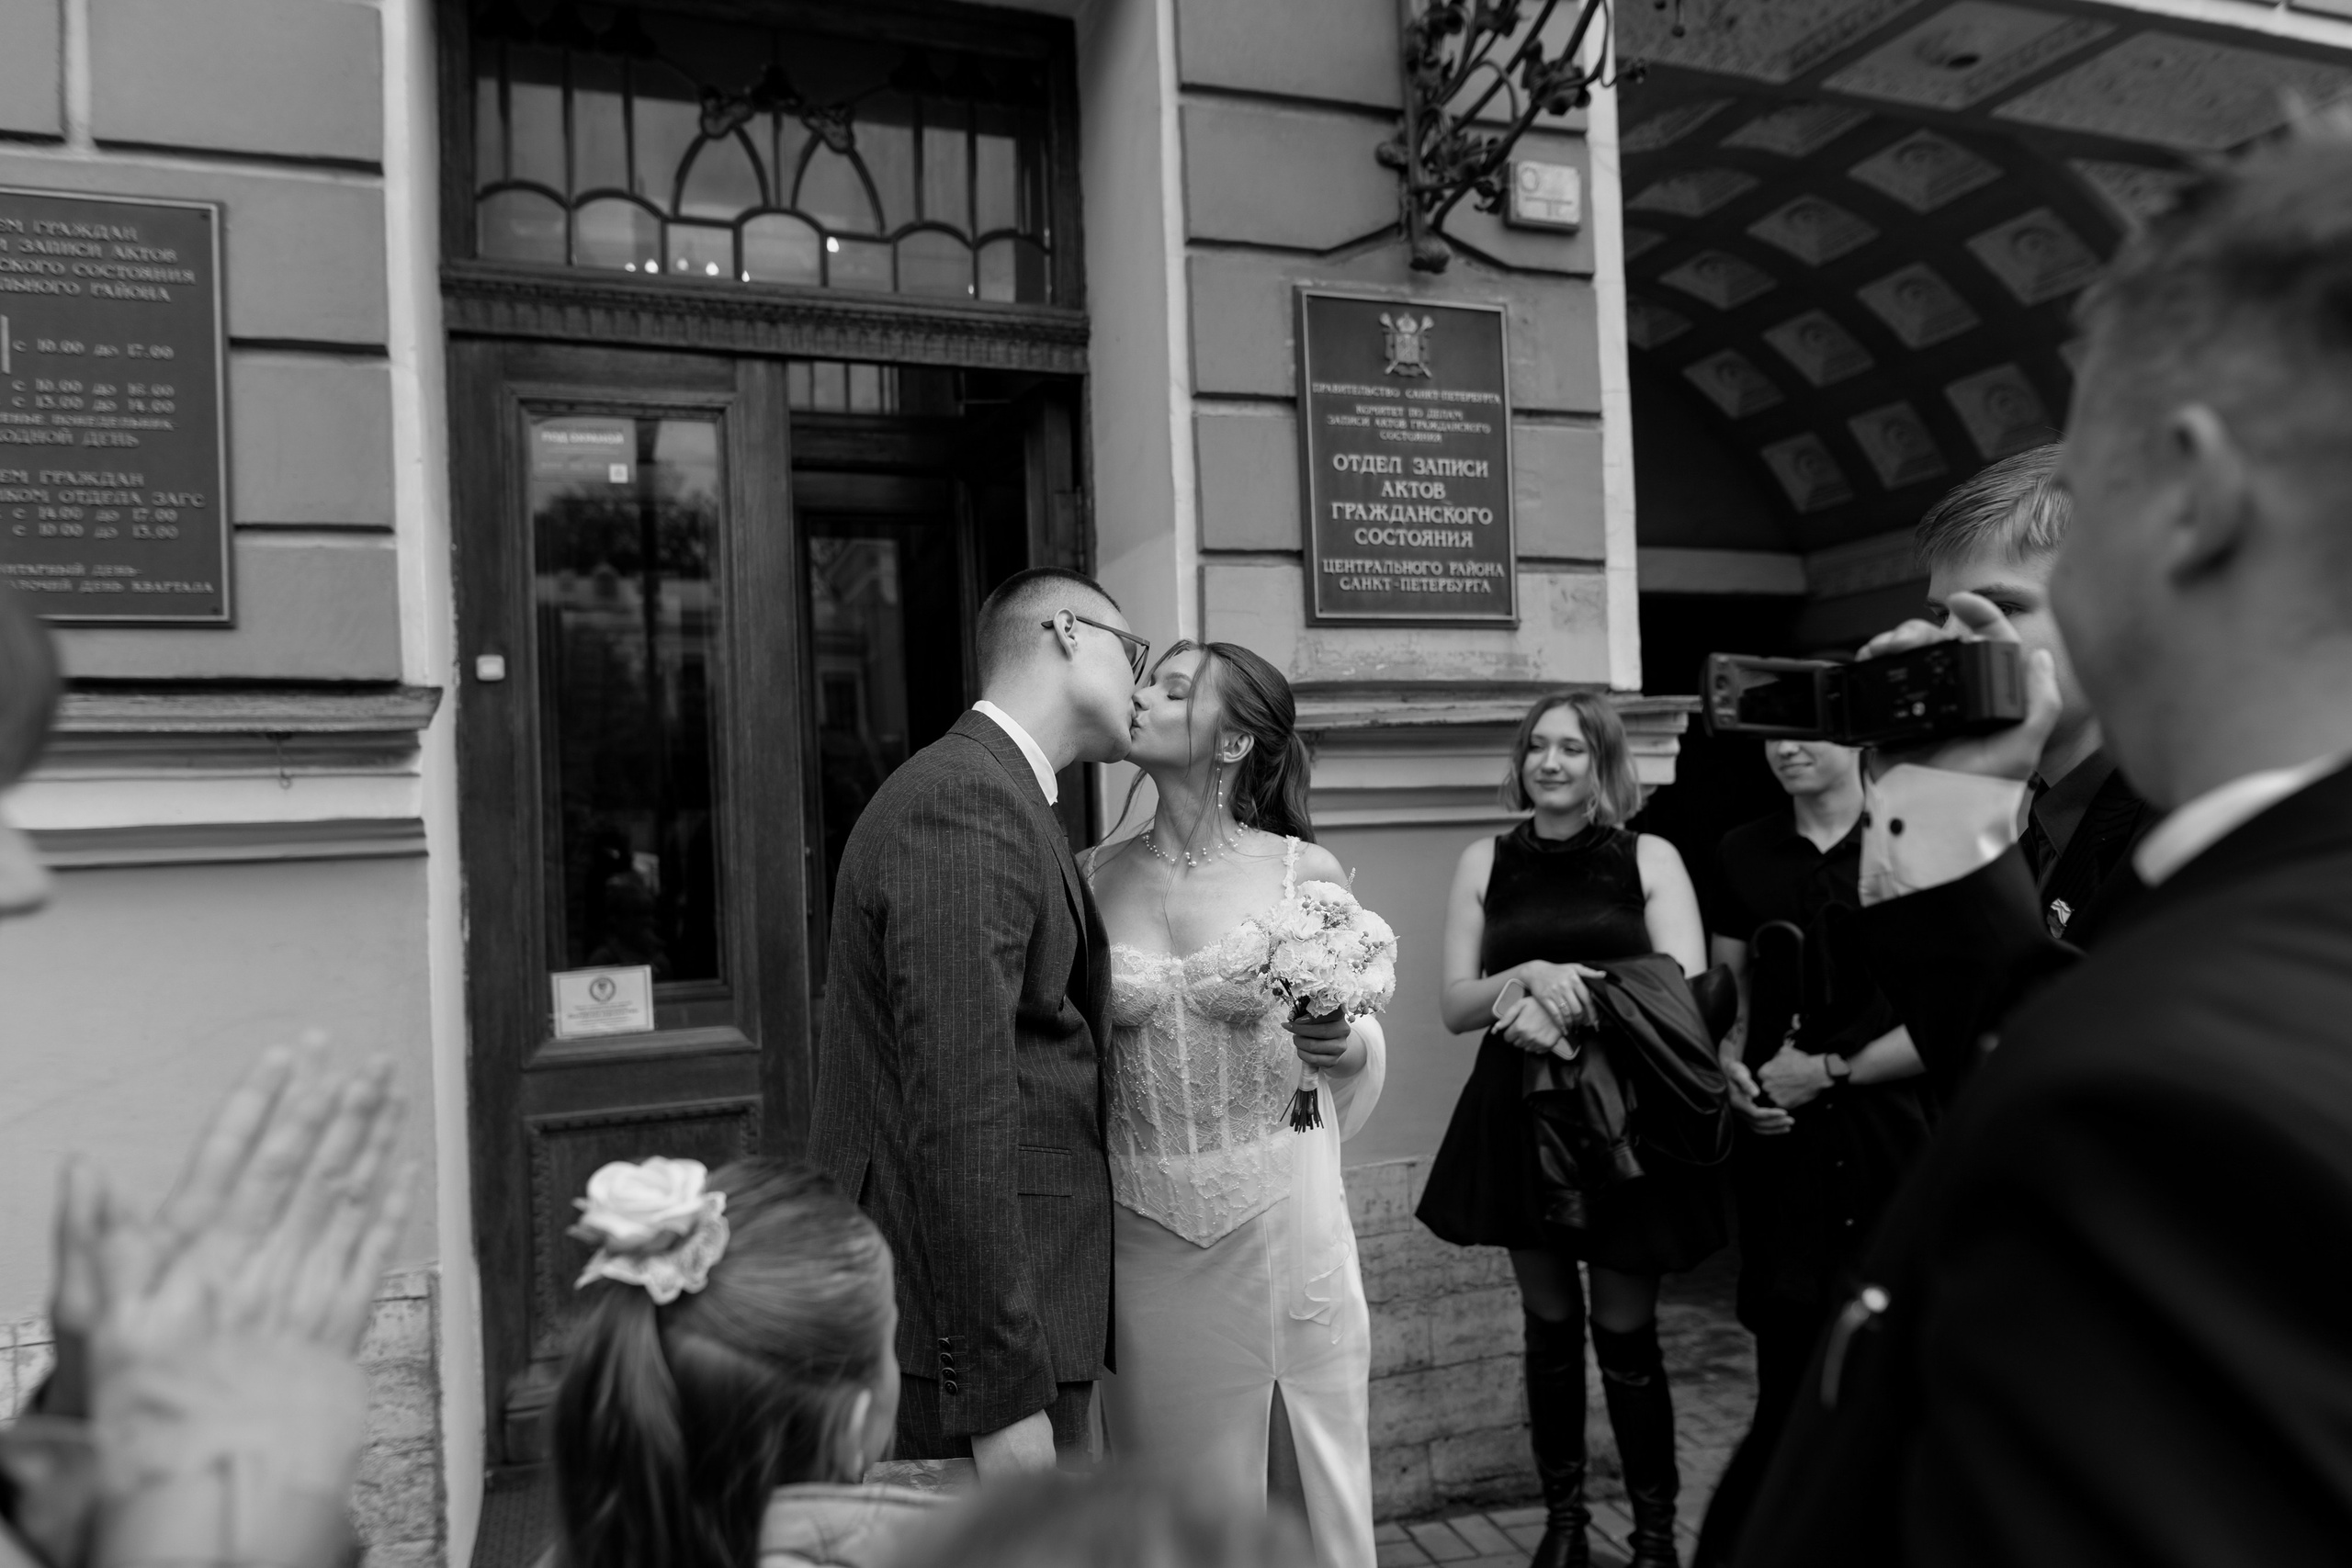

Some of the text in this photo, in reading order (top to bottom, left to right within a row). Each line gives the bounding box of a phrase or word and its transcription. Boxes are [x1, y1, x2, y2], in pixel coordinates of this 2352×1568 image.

[33, 220, 138, 243] ГРАЖДАН
[18, 238, 103, 258] ЗАПИСИ
[111, 244, 178, 265] АКТОВ
[72, 264, 196, 286] СОСТОЯНИЯ
[90, 281, 171, 303] РАЙОНА
[1312, 382, 1501, 405] ПРАВИТЕЛЬСТВО САНКТ-ПЕТЕРБУРГА
[1355, 404, 1464, 421] КОМИТЕТ ПО ДЕЛАМ
[1327, 414, 1492, 434] ЗАПИСИ АКТОВ ГРАЖДАНСКОГО
[0, 427, 140, 448] ОДНОЙ ДЕНЬ
[1379, 430, 1442, 444] СОСТОЯНИЯ
[1332, 454, 1489, 478] ОТДЕЛ ЗАПИСИ
[39, 469, 144, 489] ГРАЖДАН
[1381, 479, 1446, 500] АКТОВ
[58, 490, 144, 507] ОТДЕЛА
[151, 491, 206, 508] ЗАГС
[1331, 502, 1493, 525] ГРАЖДАНСКОГО
[1354, 527, 1474, 548] СОСТОЯНИЯ
[1322, 558, 1505, 577] ЦЕНТРАЛЬНОГО РАЙОНА
[78, 581, 125, 593] ДЕНЬ
[131, 581, 214, 594] КВАРТАЛА
[1339, 576, 1492, 593] САНКТ-ПЕТЕРБУРГА
